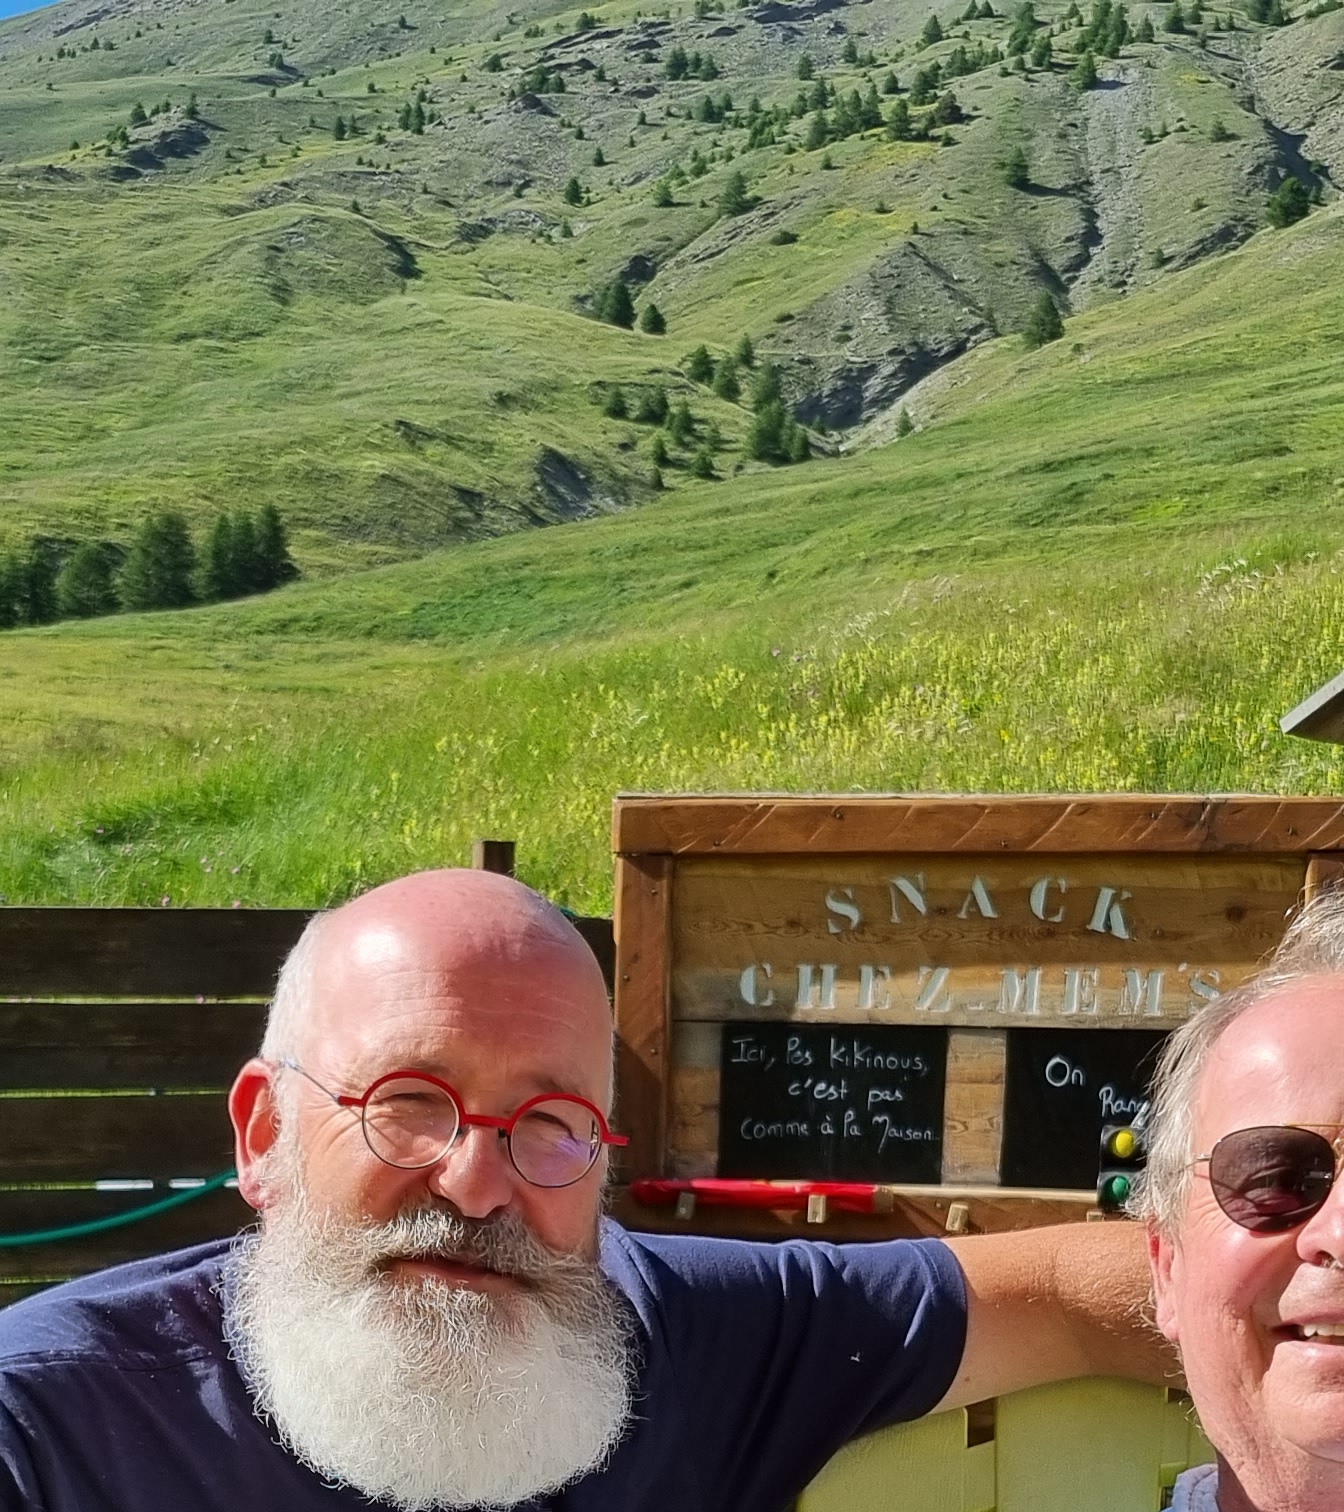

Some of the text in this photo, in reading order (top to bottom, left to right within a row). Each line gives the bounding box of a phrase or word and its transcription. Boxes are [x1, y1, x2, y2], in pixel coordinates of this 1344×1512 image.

[825, 871, 1131, 939] SNACK
[739, 963, 951, 1013] CHEZ
[1045, 1056, 1084, 1087] On
[788, 1078, 904, 1111] c'est pas
[820, 1115, 835, 1135] à
